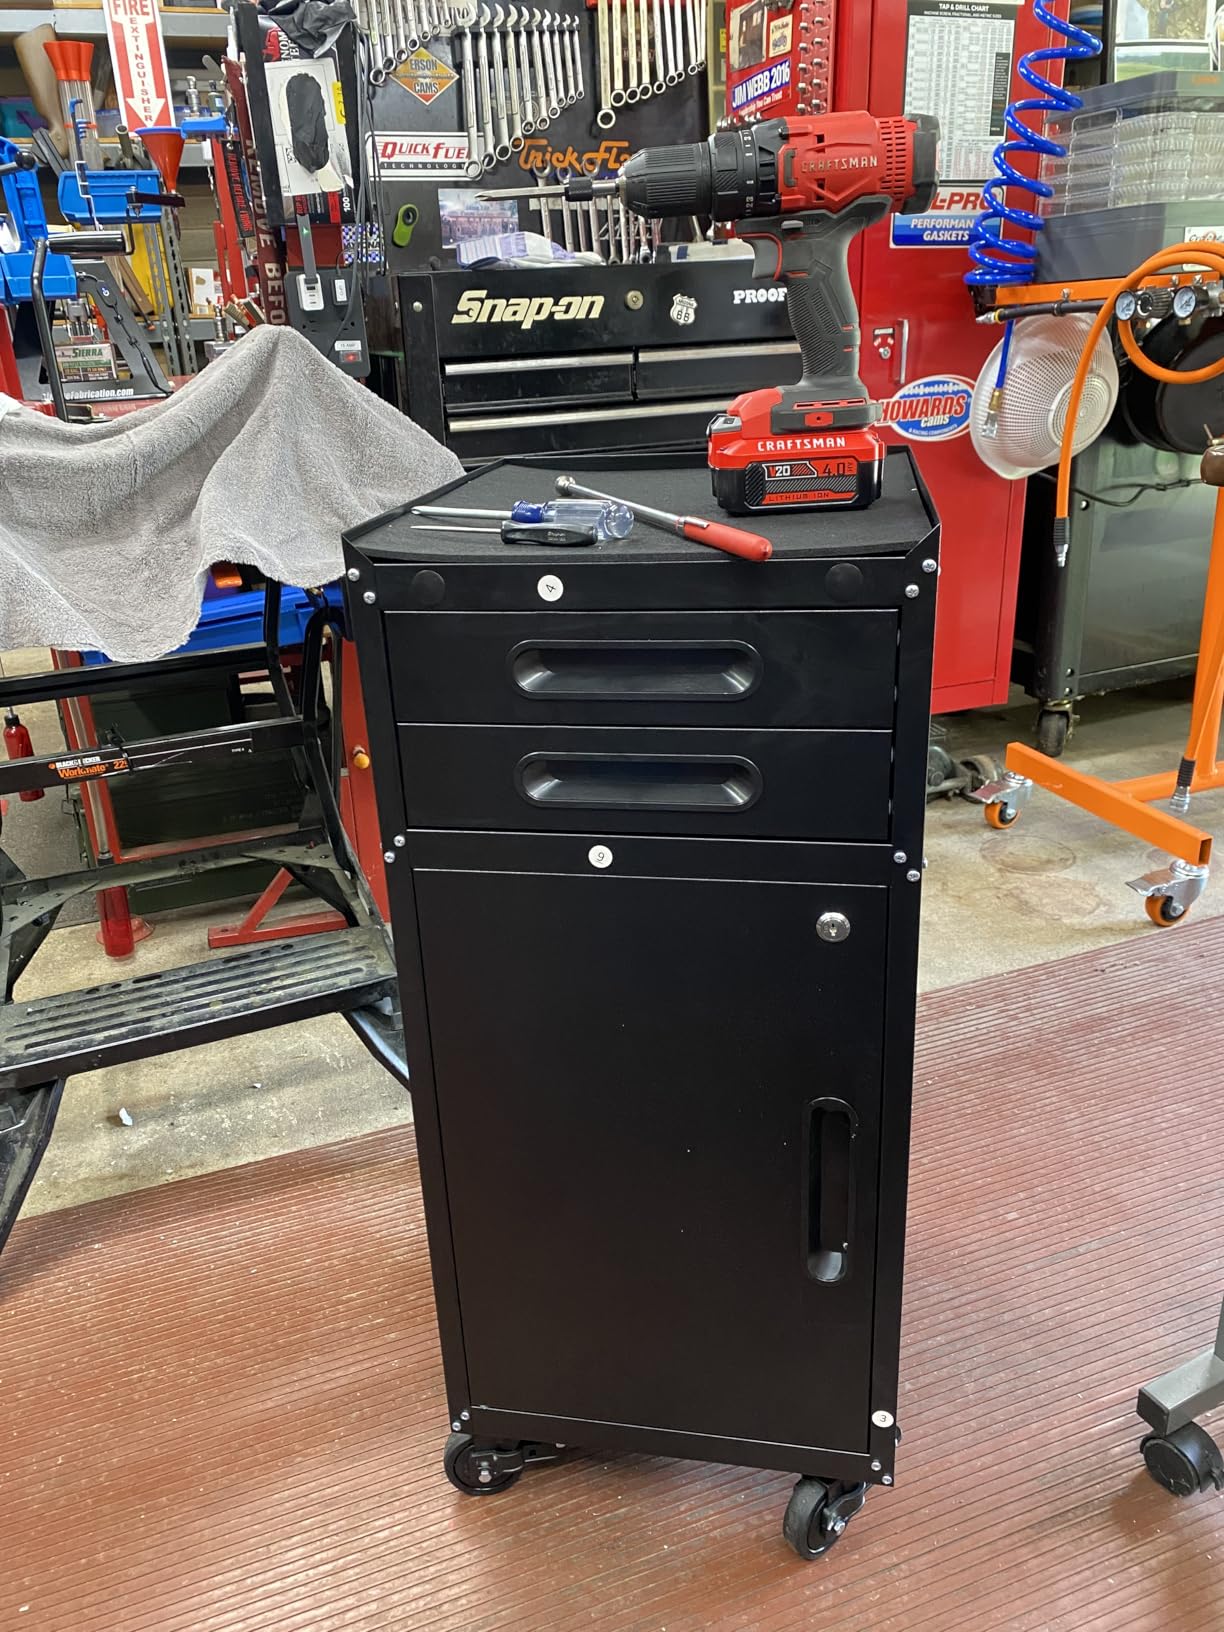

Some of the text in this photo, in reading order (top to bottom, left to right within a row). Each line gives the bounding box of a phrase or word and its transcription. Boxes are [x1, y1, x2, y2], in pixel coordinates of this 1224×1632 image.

[111, 0, 150, 16] FIRE
[129, 17, 153, 121] EXTINGUISHER
[410, 58, 438, 71] ERSON
[413, 82, 439, 94] CAMS
[732, 61, 790, 108] JIM WEBB 2016
[801, 156, 877, 173] CRAFTSMAN
[342, 196, 351, 213] 100
[910, 218, 975, 229] PERFORMAN
[923, 230, 970, 241] GASKETS
[264, 262, 287, 325] BEFO
[451, 289, 605, 329] Snap-on
[73, 348, 102, 359] SIERRA
[920, 414, 950, 428] cams
[757, 436, 846, 452] CRAFTSMAN
[769, 466, 791, 477] V20
[822, 462, 846, 477] 4.0
[768, 492, 830, 502] LITHIUM ION
[545, 584, 556, 593] 4
